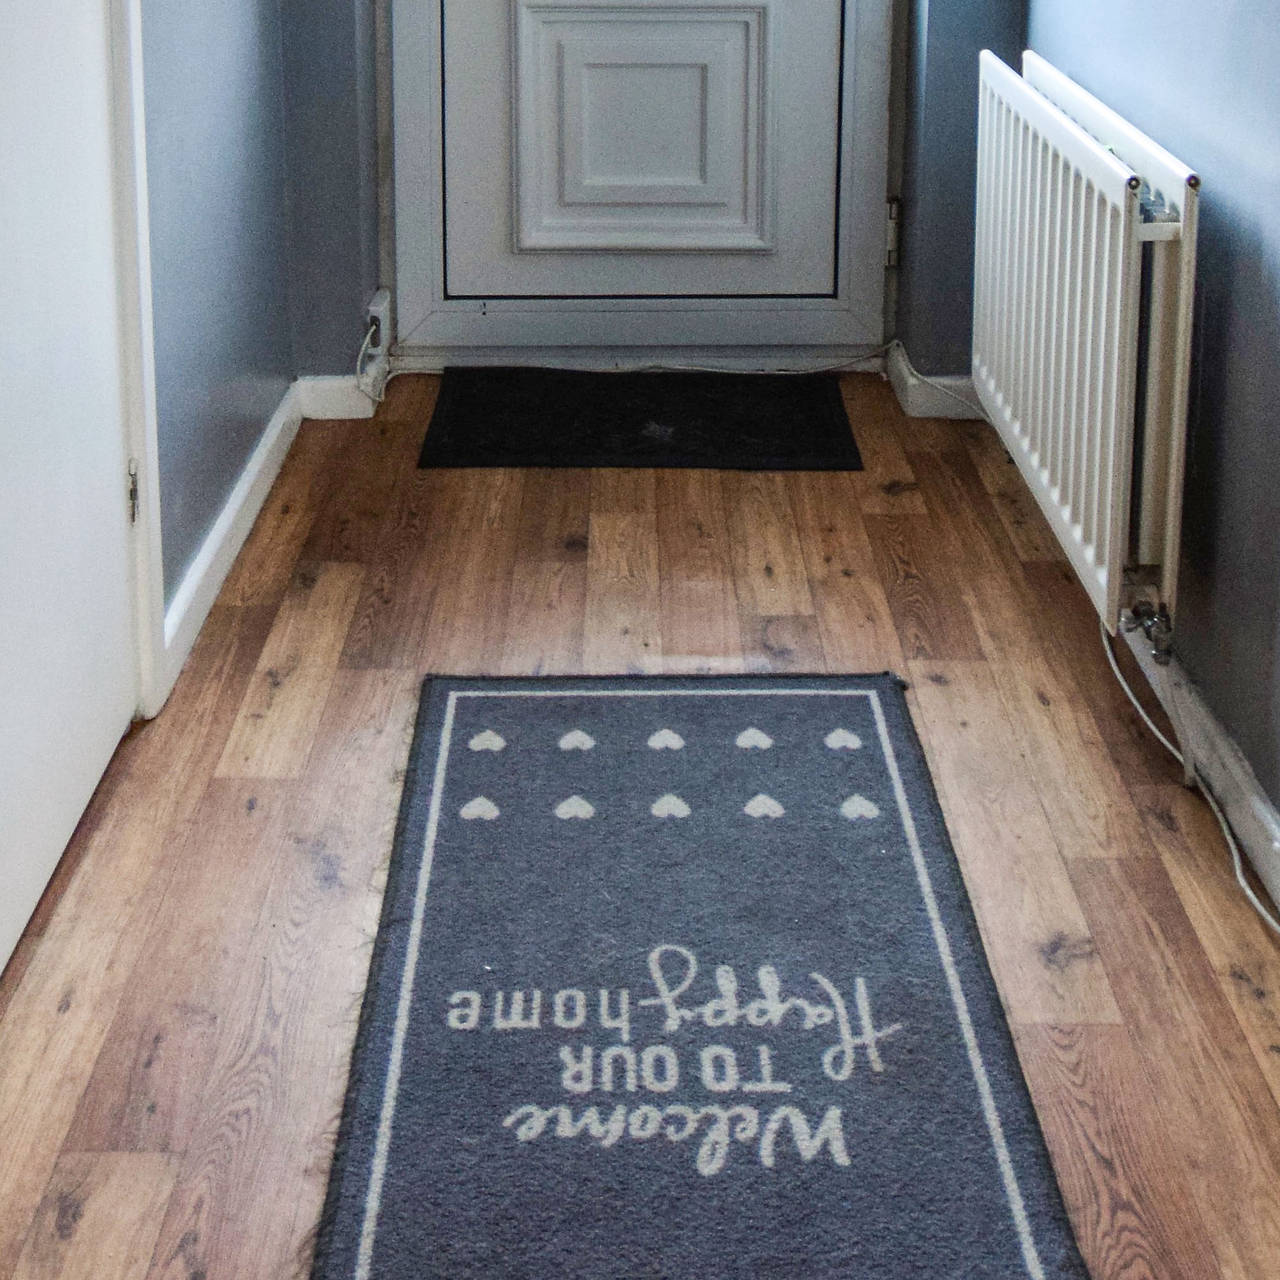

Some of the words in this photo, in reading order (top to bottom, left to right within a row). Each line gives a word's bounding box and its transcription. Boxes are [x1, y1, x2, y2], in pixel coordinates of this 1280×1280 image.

[447, 988, 630, 1042] home
[638, 943, 903, 1081] Happy
[559, 1044, 679, 1094] OUR
[699, 1044, 793, 1094] TO
[502, 1103, 852, 1176] Welcome
